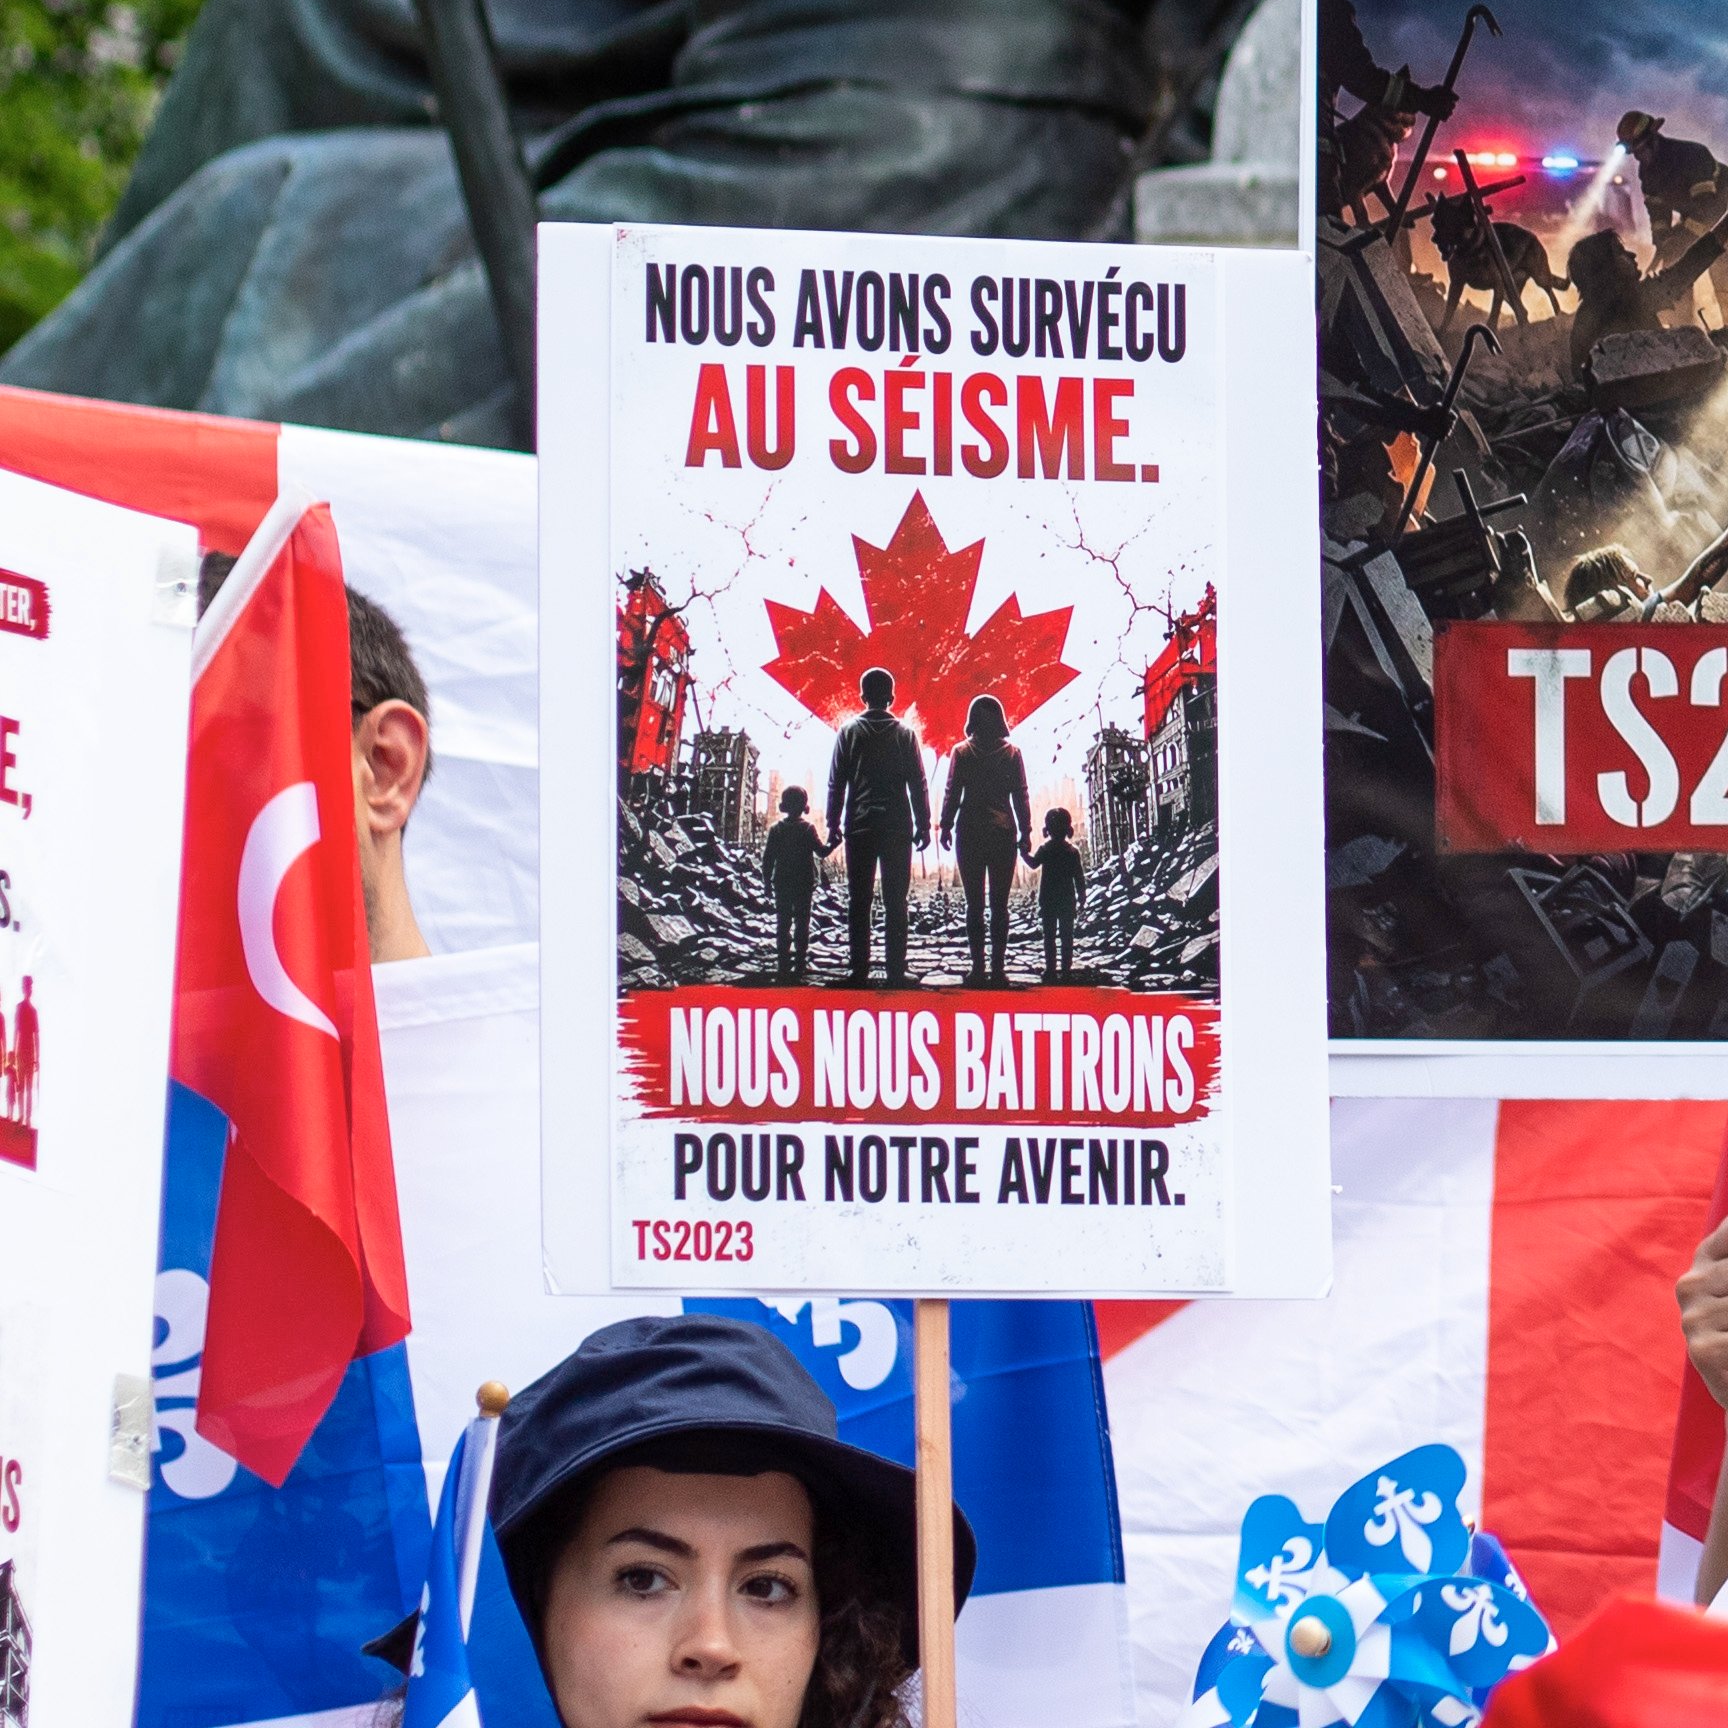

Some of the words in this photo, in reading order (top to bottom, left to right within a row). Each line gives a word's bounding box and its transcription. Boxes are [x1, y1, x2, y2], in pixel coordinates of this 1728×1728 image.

[647, 263, 775, 347] NOUS
[794, 270, 951, 354] AVONS
[971, 267, 1185, 362] SURVÉCU
[685, 364, 795, 470] AU
[829, 355, 1160, 483] SÉISME.
[671, 1007, 799, 1107] NOUS
[814, 1010, 940, 1110] NOUS
[955, 1013, 1194, 1113] BATTRONS
[675, 1133, 805, 1201] POUR
[826, 1136, 979, 1202] NOTRE
[998, 1138, 1184, 1205] AVENIR.
[633, 1220, 754, 1261] TS2023
